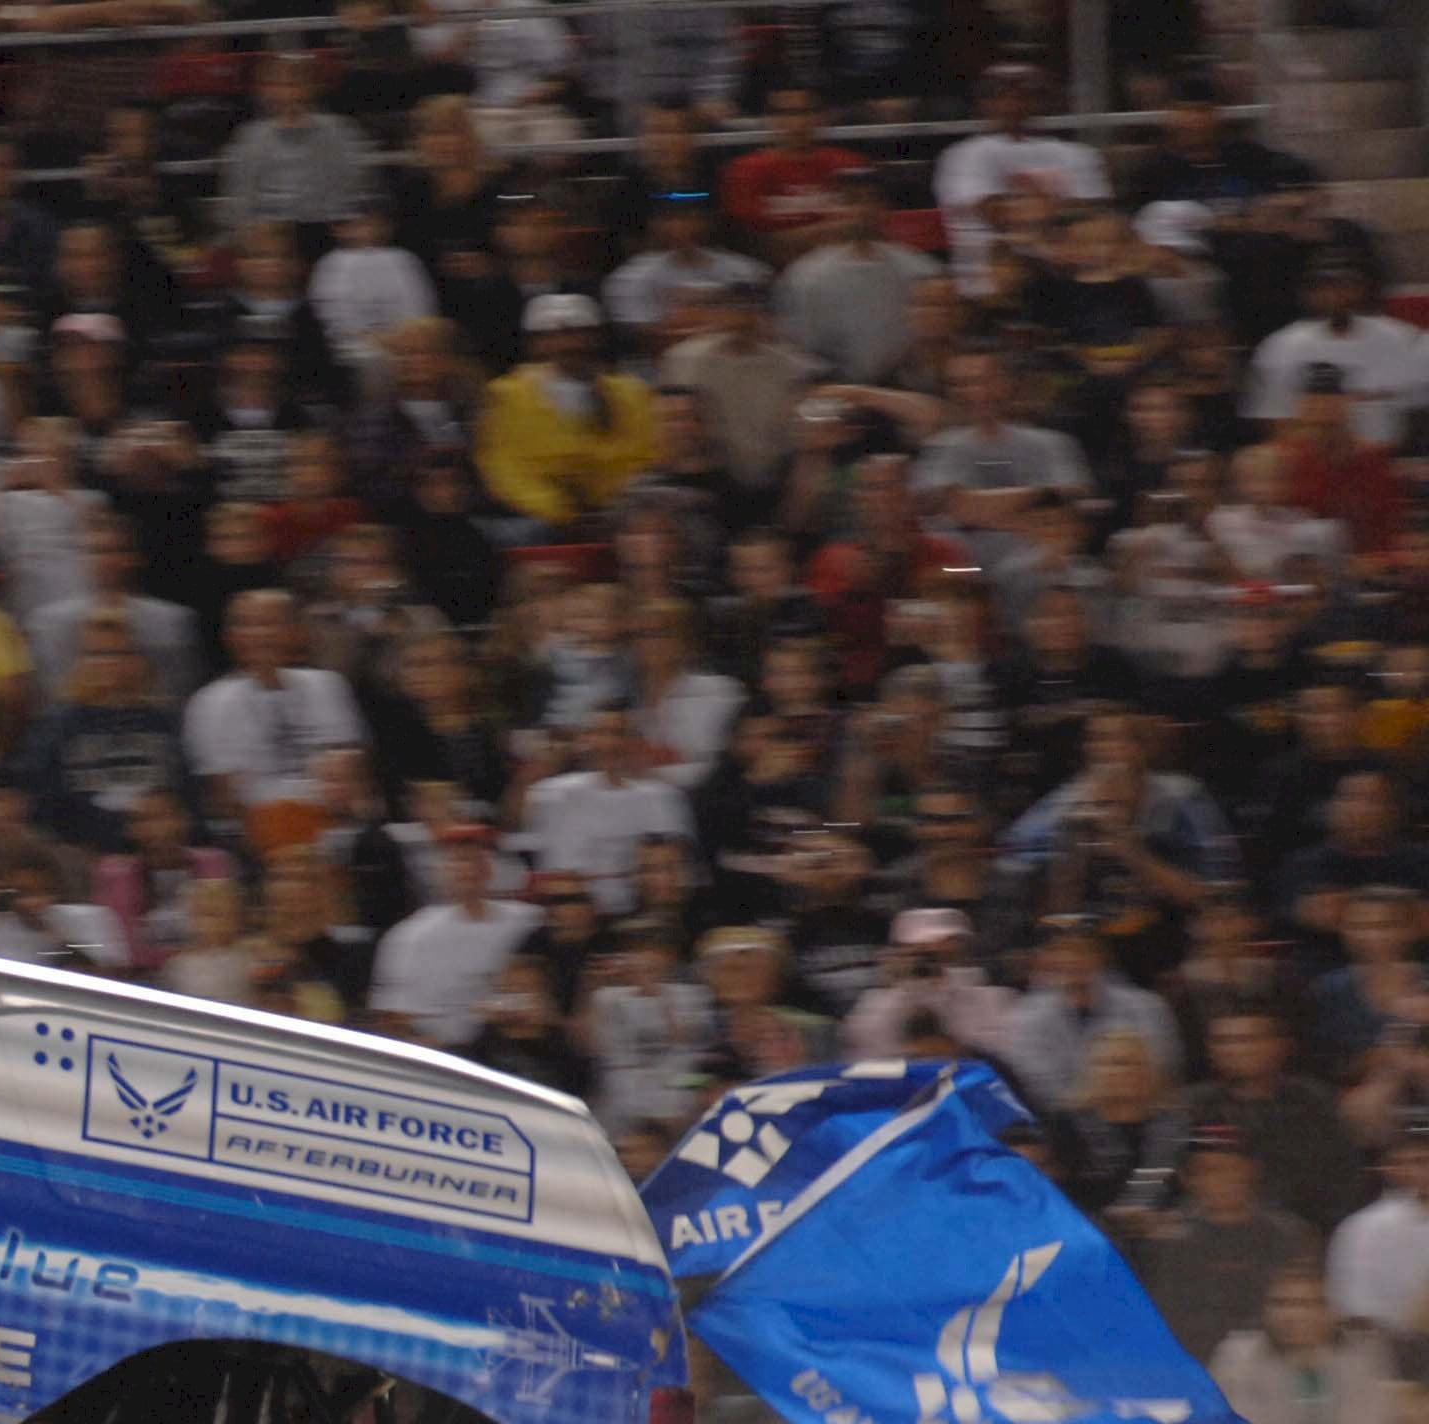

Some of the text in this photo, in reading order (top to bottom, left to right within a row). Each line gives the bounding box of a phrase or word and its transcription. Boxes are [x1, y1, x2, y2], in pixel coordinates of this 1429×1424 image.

[229, 1082, 504, 1156] U.S. AIR FORCE
[226, 1134, 518, 1204] AFTERBURNER
[670, 1204, 753, 1250] AIR
